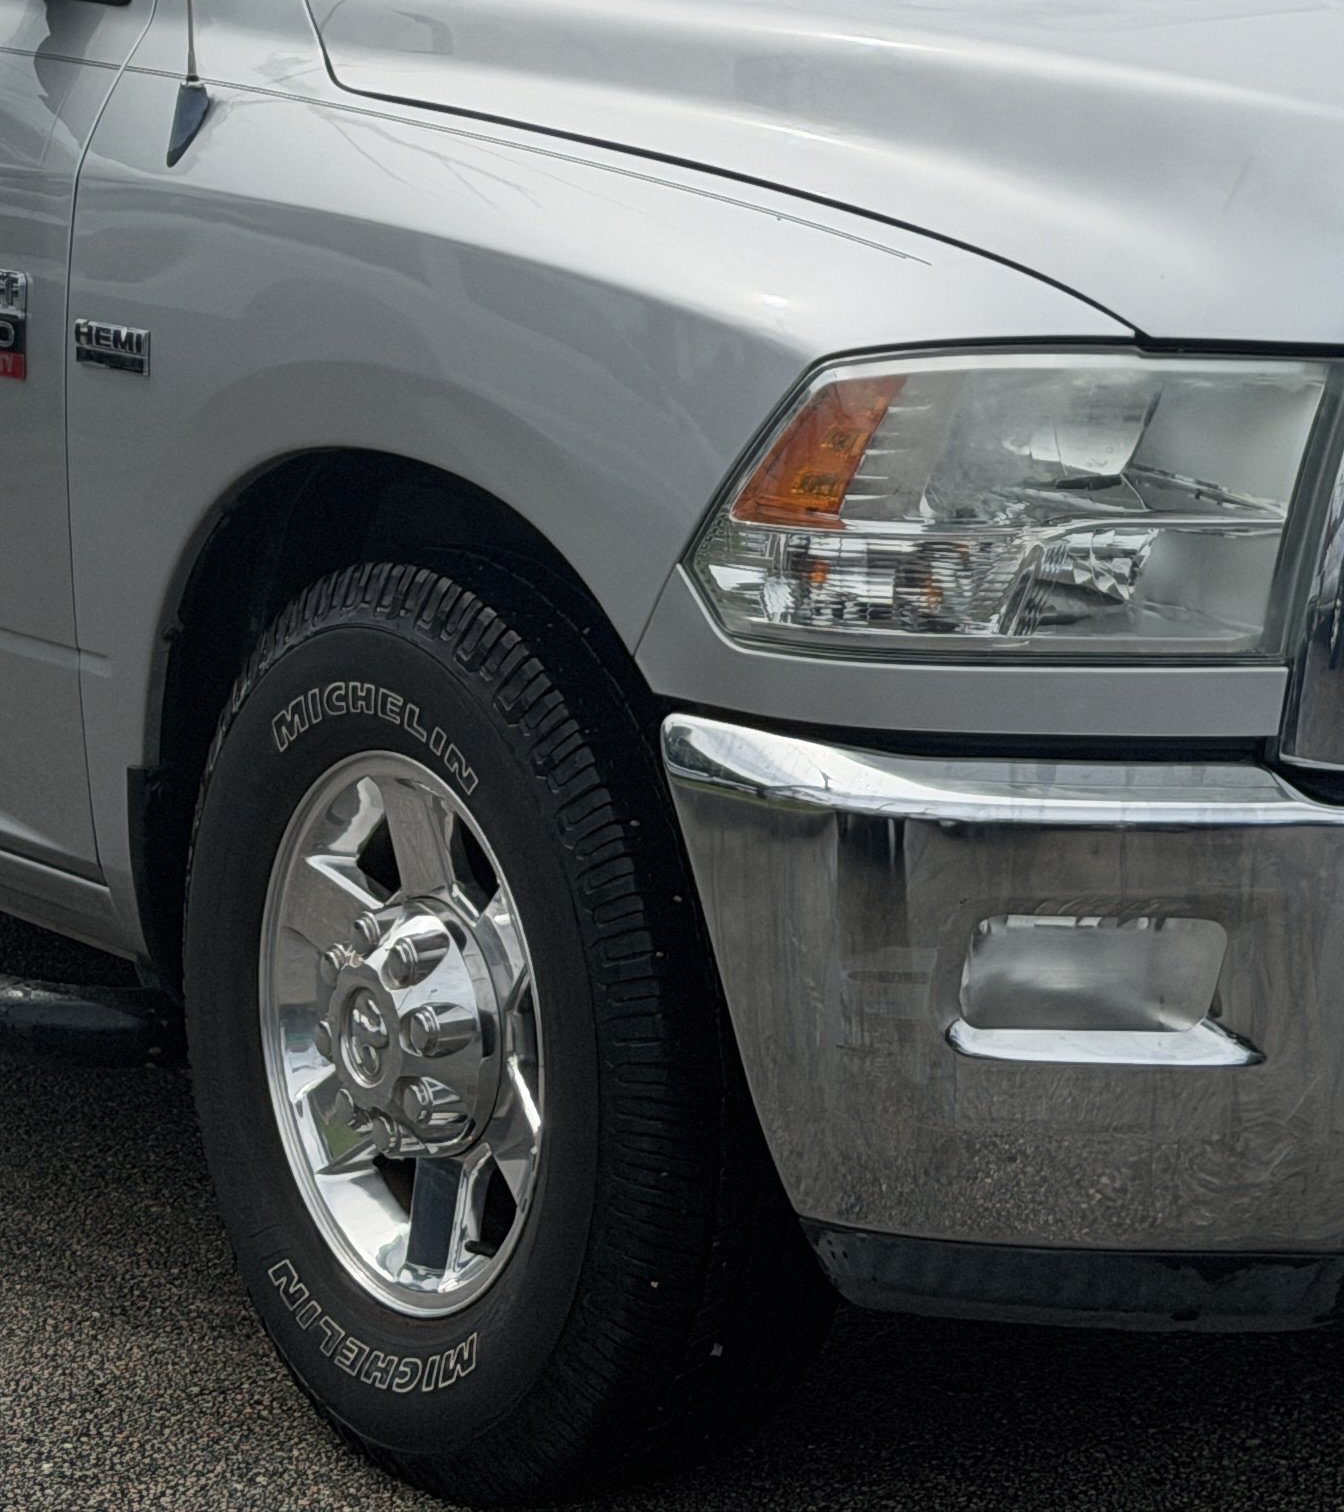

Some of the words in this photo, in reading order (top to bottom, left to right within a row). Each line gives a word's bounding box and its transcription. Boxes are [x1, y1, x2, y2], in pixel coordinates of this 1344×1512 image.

[74, 319, 151, 360] HEMI
[271, 681, 480, 797] MICHELIN
[267, 1258, 479, 1394] MICHELIN
